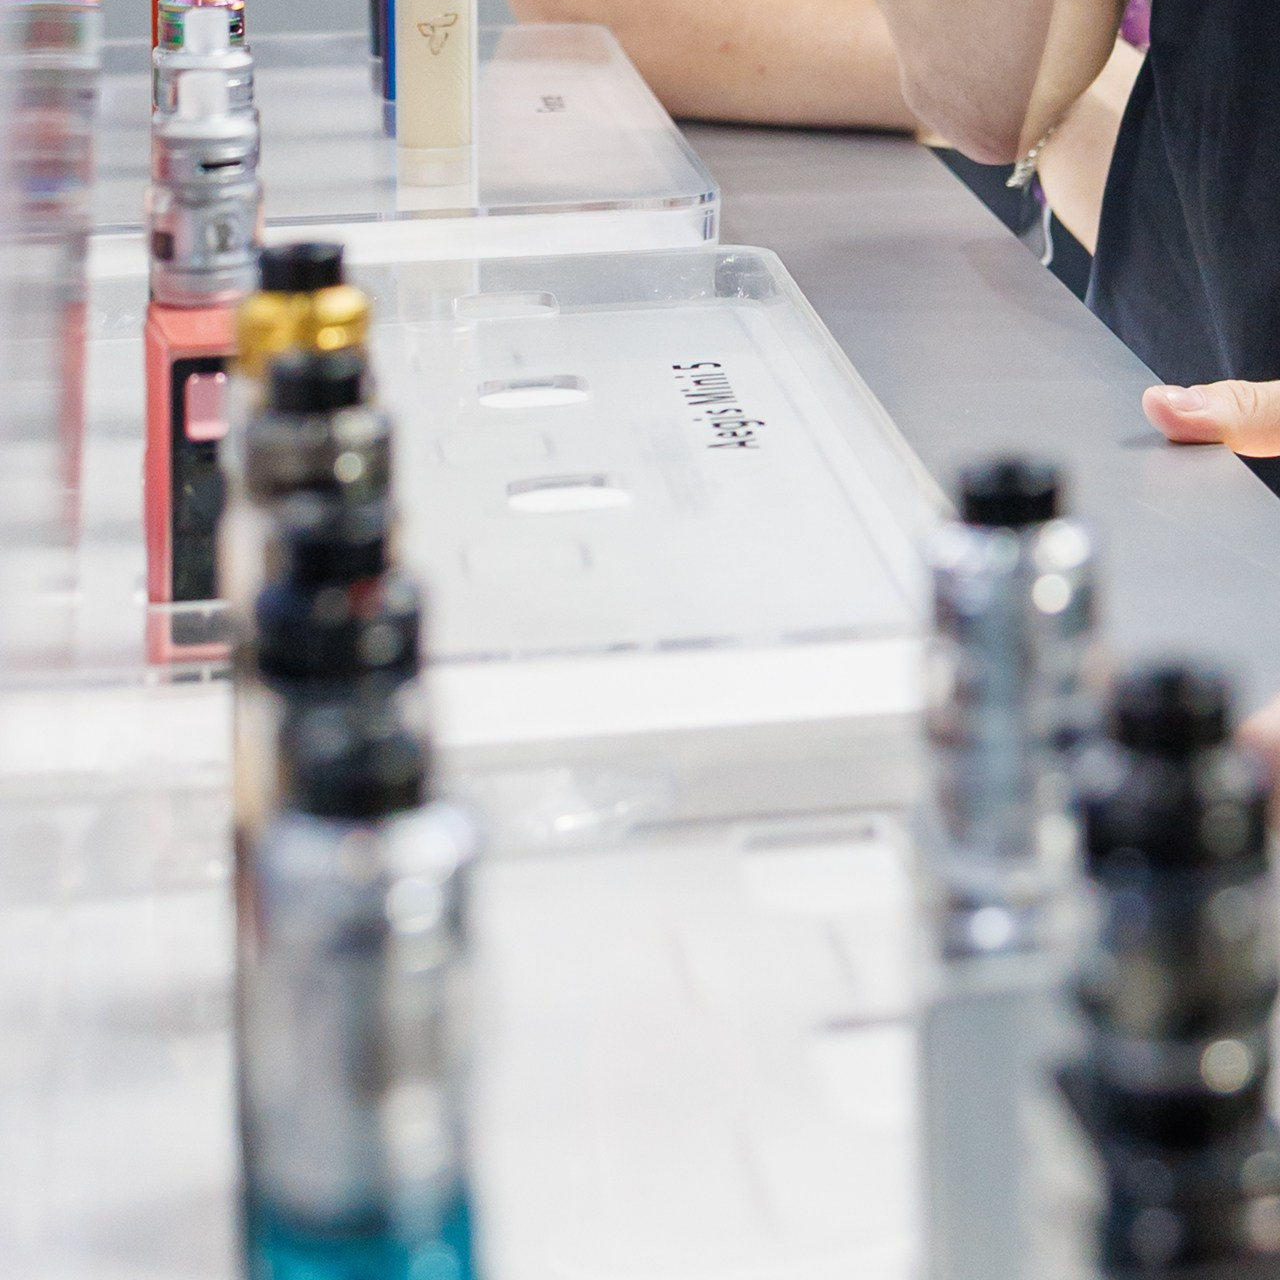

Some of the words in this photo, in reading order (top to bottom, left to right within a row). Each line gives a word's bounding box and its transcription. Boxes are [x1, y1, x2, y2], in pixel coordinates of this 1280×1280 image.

[672, 361, 722, 371] 5
[674, 372, 738, 406] Mini
[692, 408, 765, 449] Aegis
